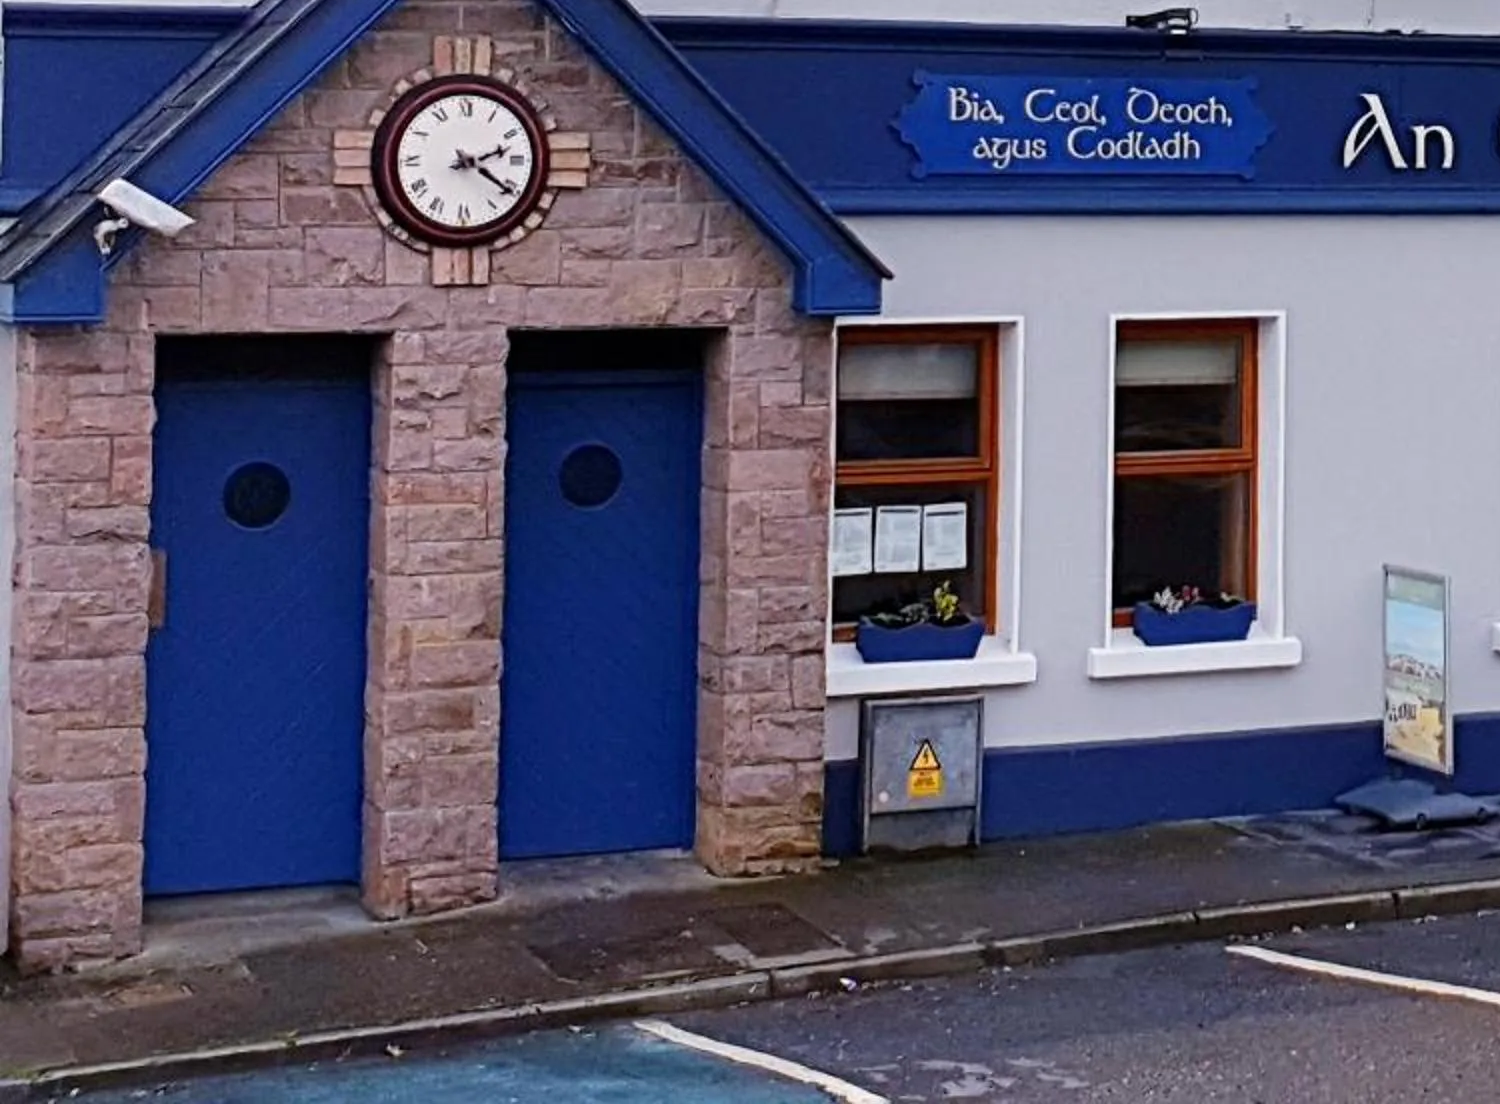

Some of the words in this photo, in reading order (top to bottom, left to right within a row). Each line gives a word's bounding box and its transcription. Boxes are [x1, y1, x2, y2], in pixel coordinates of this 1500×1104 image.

[949, 87, 1004, 126] Bia,
[1025, 89, 1107, 127] Ceol,
[1126, 87, 1233, 129] Deoch,
[972, 135, 1047, 169] agus
[1066, 125, 1201, 160] Codladh
[1342, 93, 1454, 169] An
